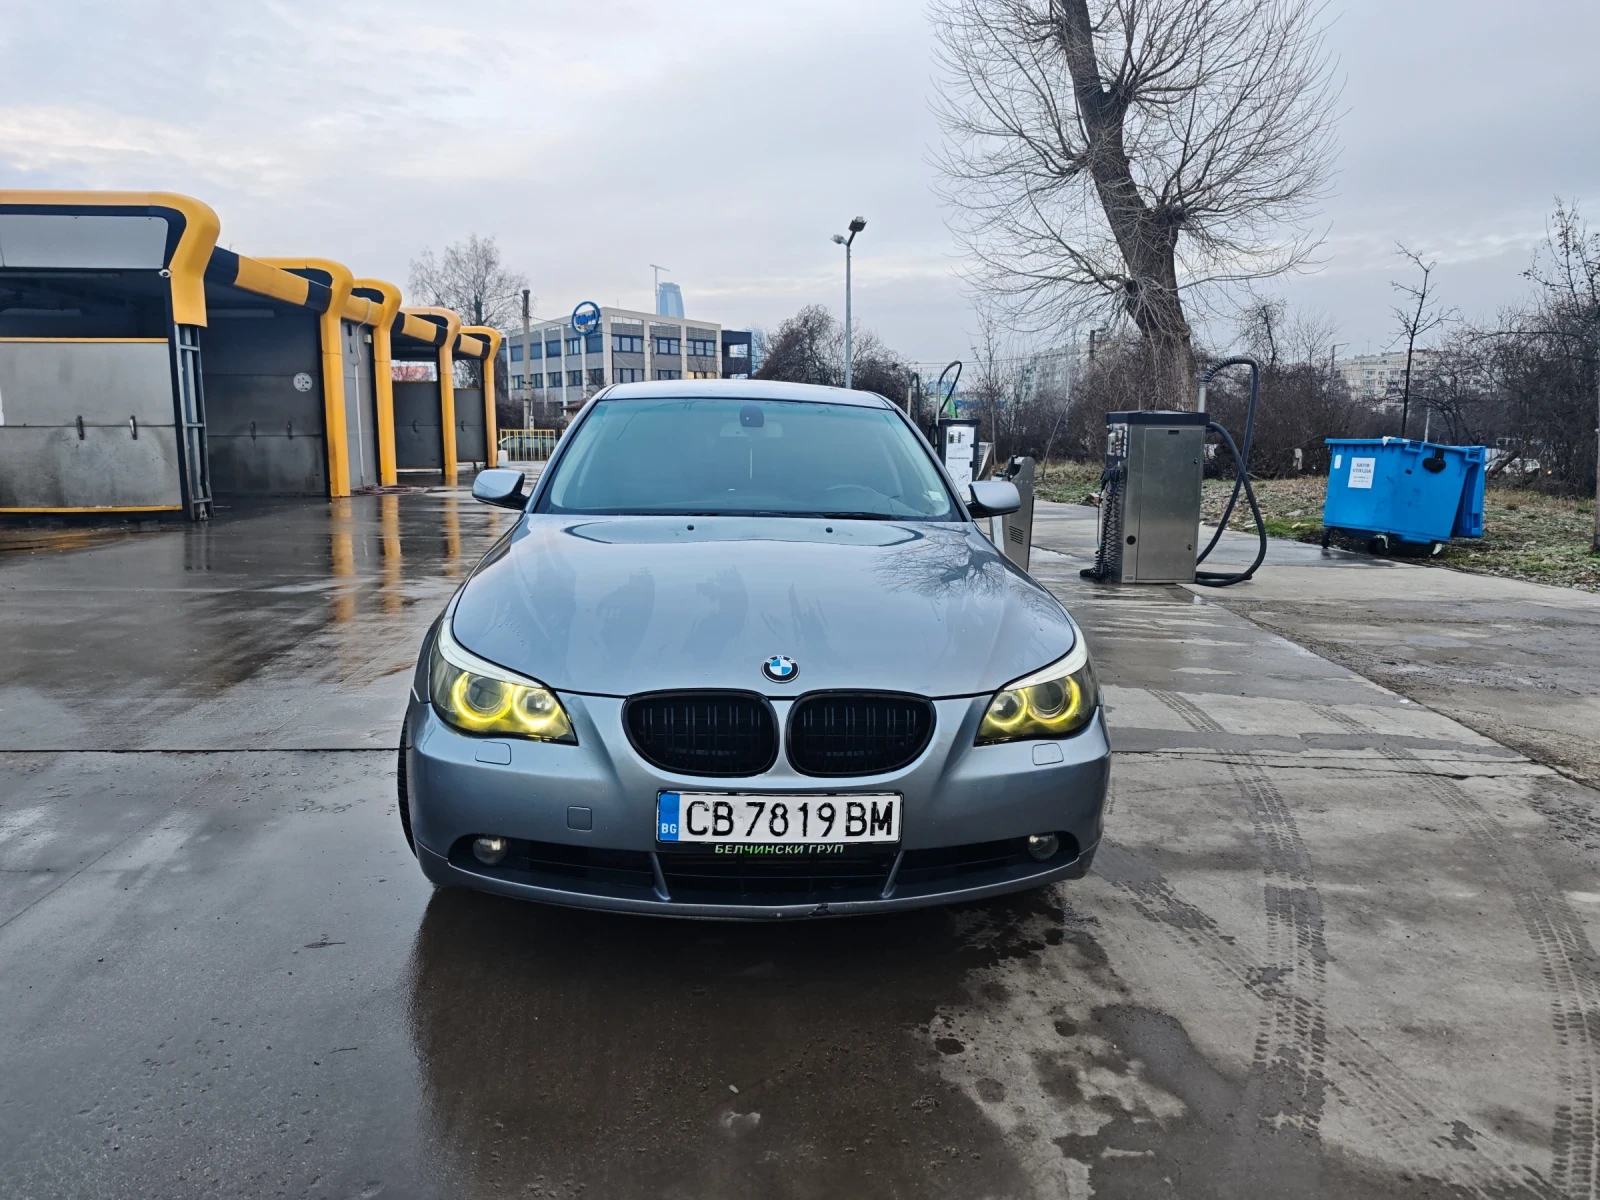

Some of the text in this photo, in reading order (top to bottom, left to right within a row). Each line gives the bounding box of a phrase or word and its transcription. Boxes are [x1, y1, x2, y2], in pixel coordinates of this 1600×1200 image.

[745, 801, 836, 837] 7819
[661, 823, 677, 834] BG
[714, 844, 844, 854] БЕЛЧИНСКИ ГРУП
